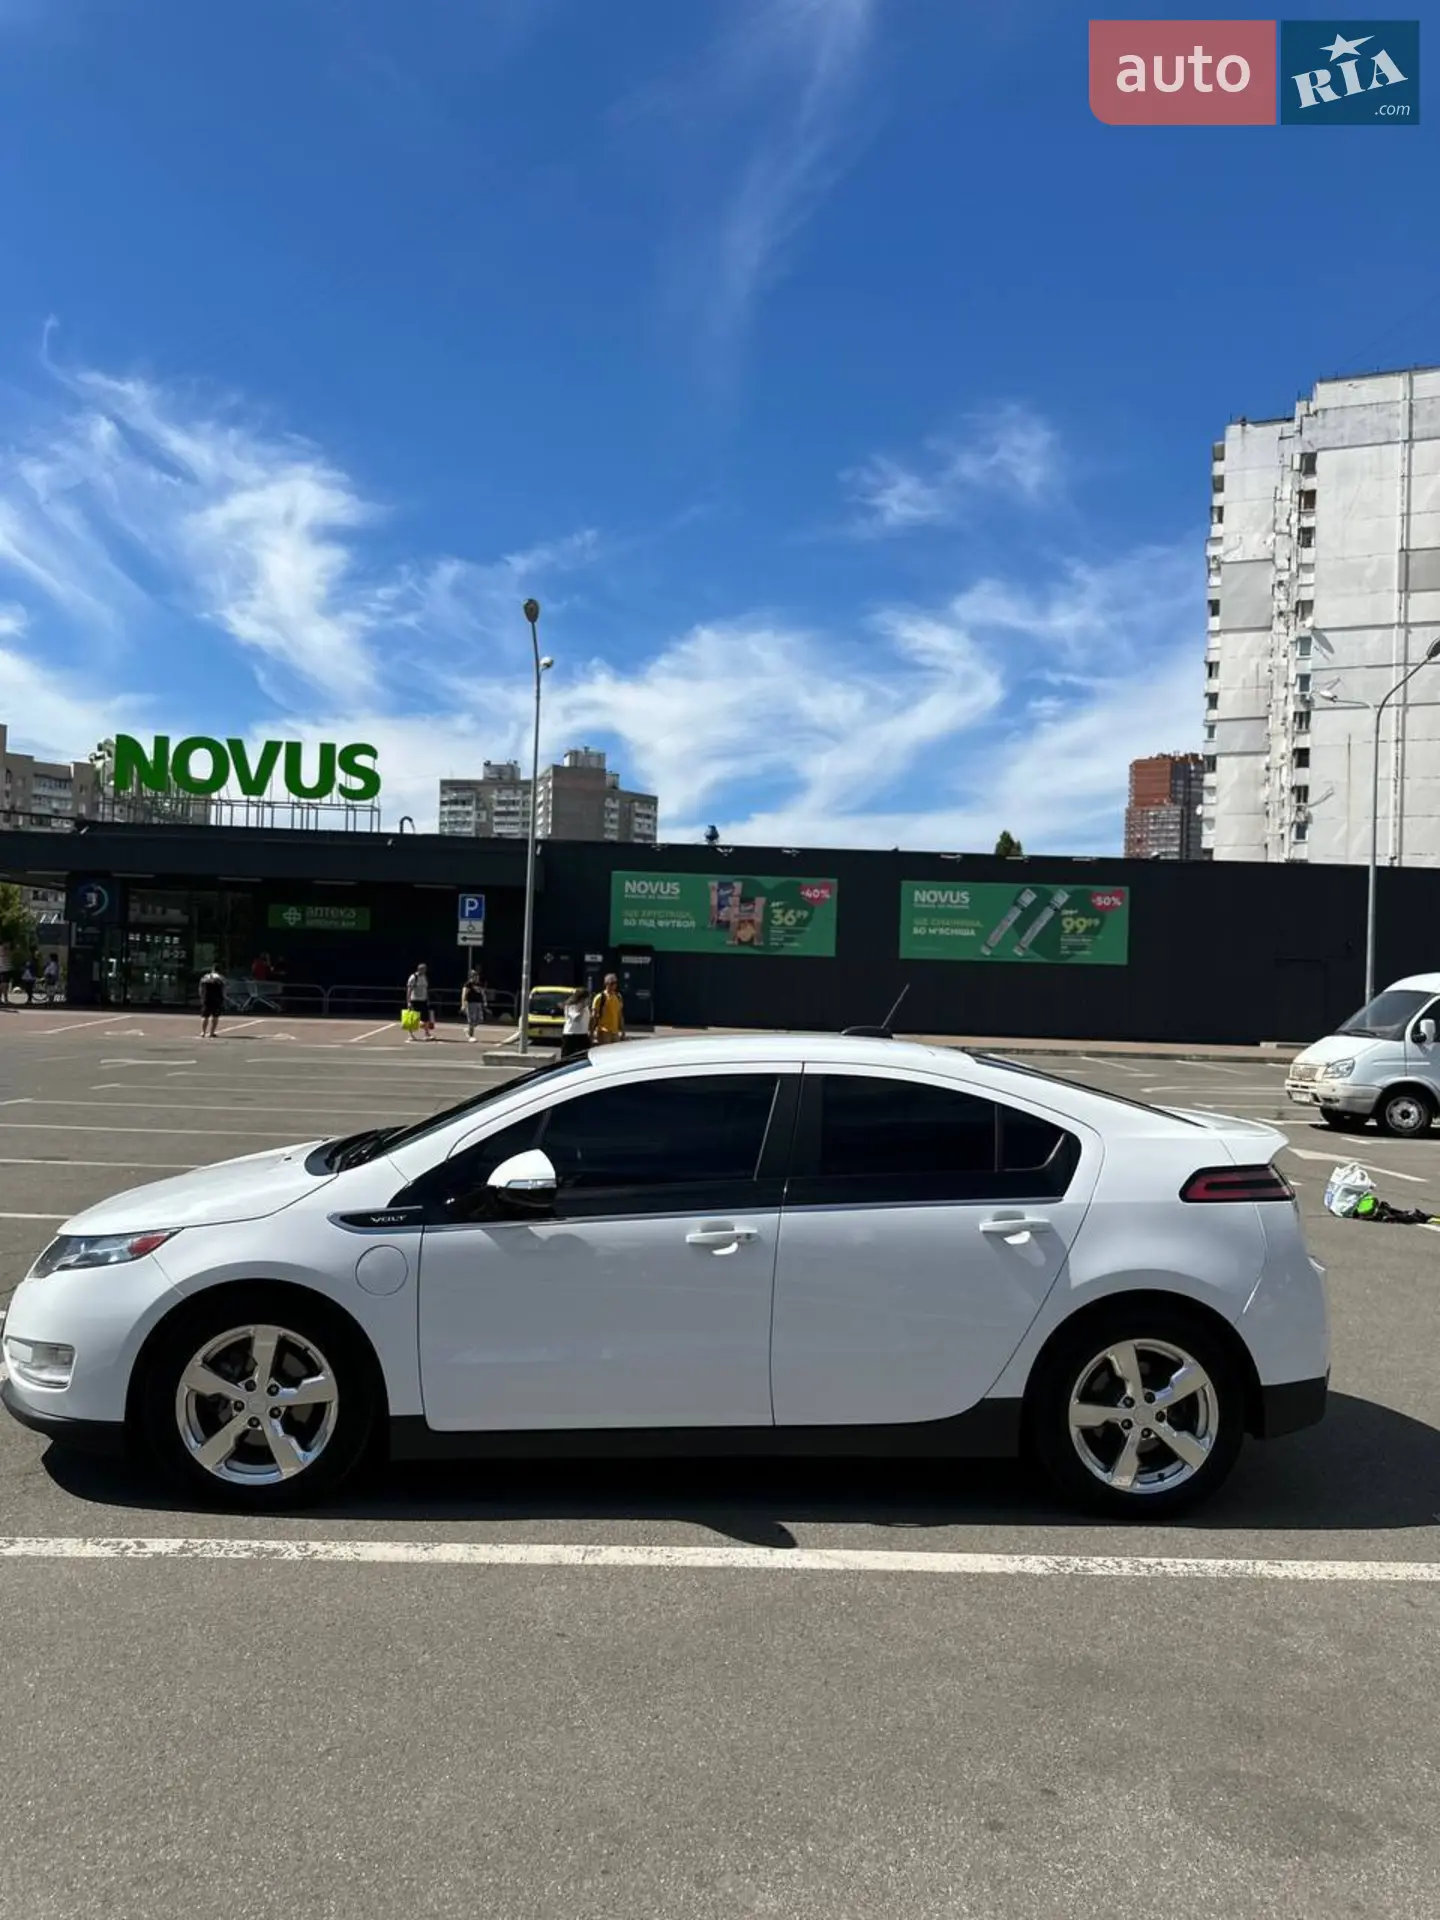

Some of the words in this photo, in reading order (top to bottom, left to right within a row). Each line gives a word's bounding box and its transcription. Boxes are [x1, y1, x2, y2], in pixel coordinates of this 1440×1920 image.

[115, 734, 381, 801] NOVUS
[624, 880, 681, 895] NOVUS
[801, 888, 830, 899] -40%
[913, 889, 970, 904] NOVUS
[1092, 895, 1122, 906] -50%
[464, 897, 479, 917] P
[370, 1215, 408, 1223] VOLT
